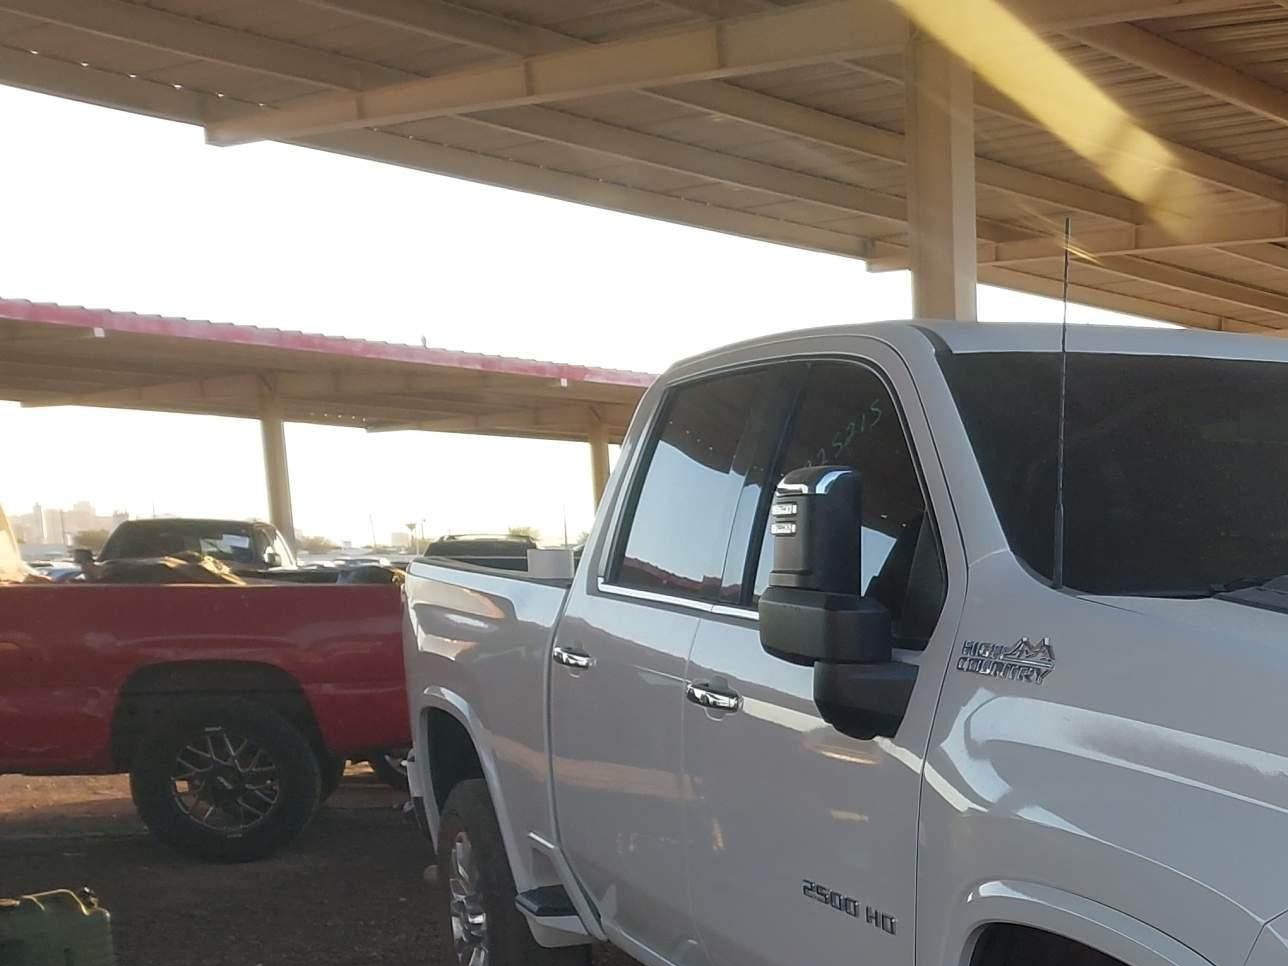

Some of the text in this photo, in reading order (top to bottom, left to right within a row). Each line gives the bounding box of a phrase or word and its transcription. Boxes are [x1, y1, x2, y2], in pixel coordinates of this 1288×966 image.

[962, 640, 1008, 659] HIGH
[956, 657, 1052, 685] COUNTRY
[802, 879, 897, 935] 2500 HD
